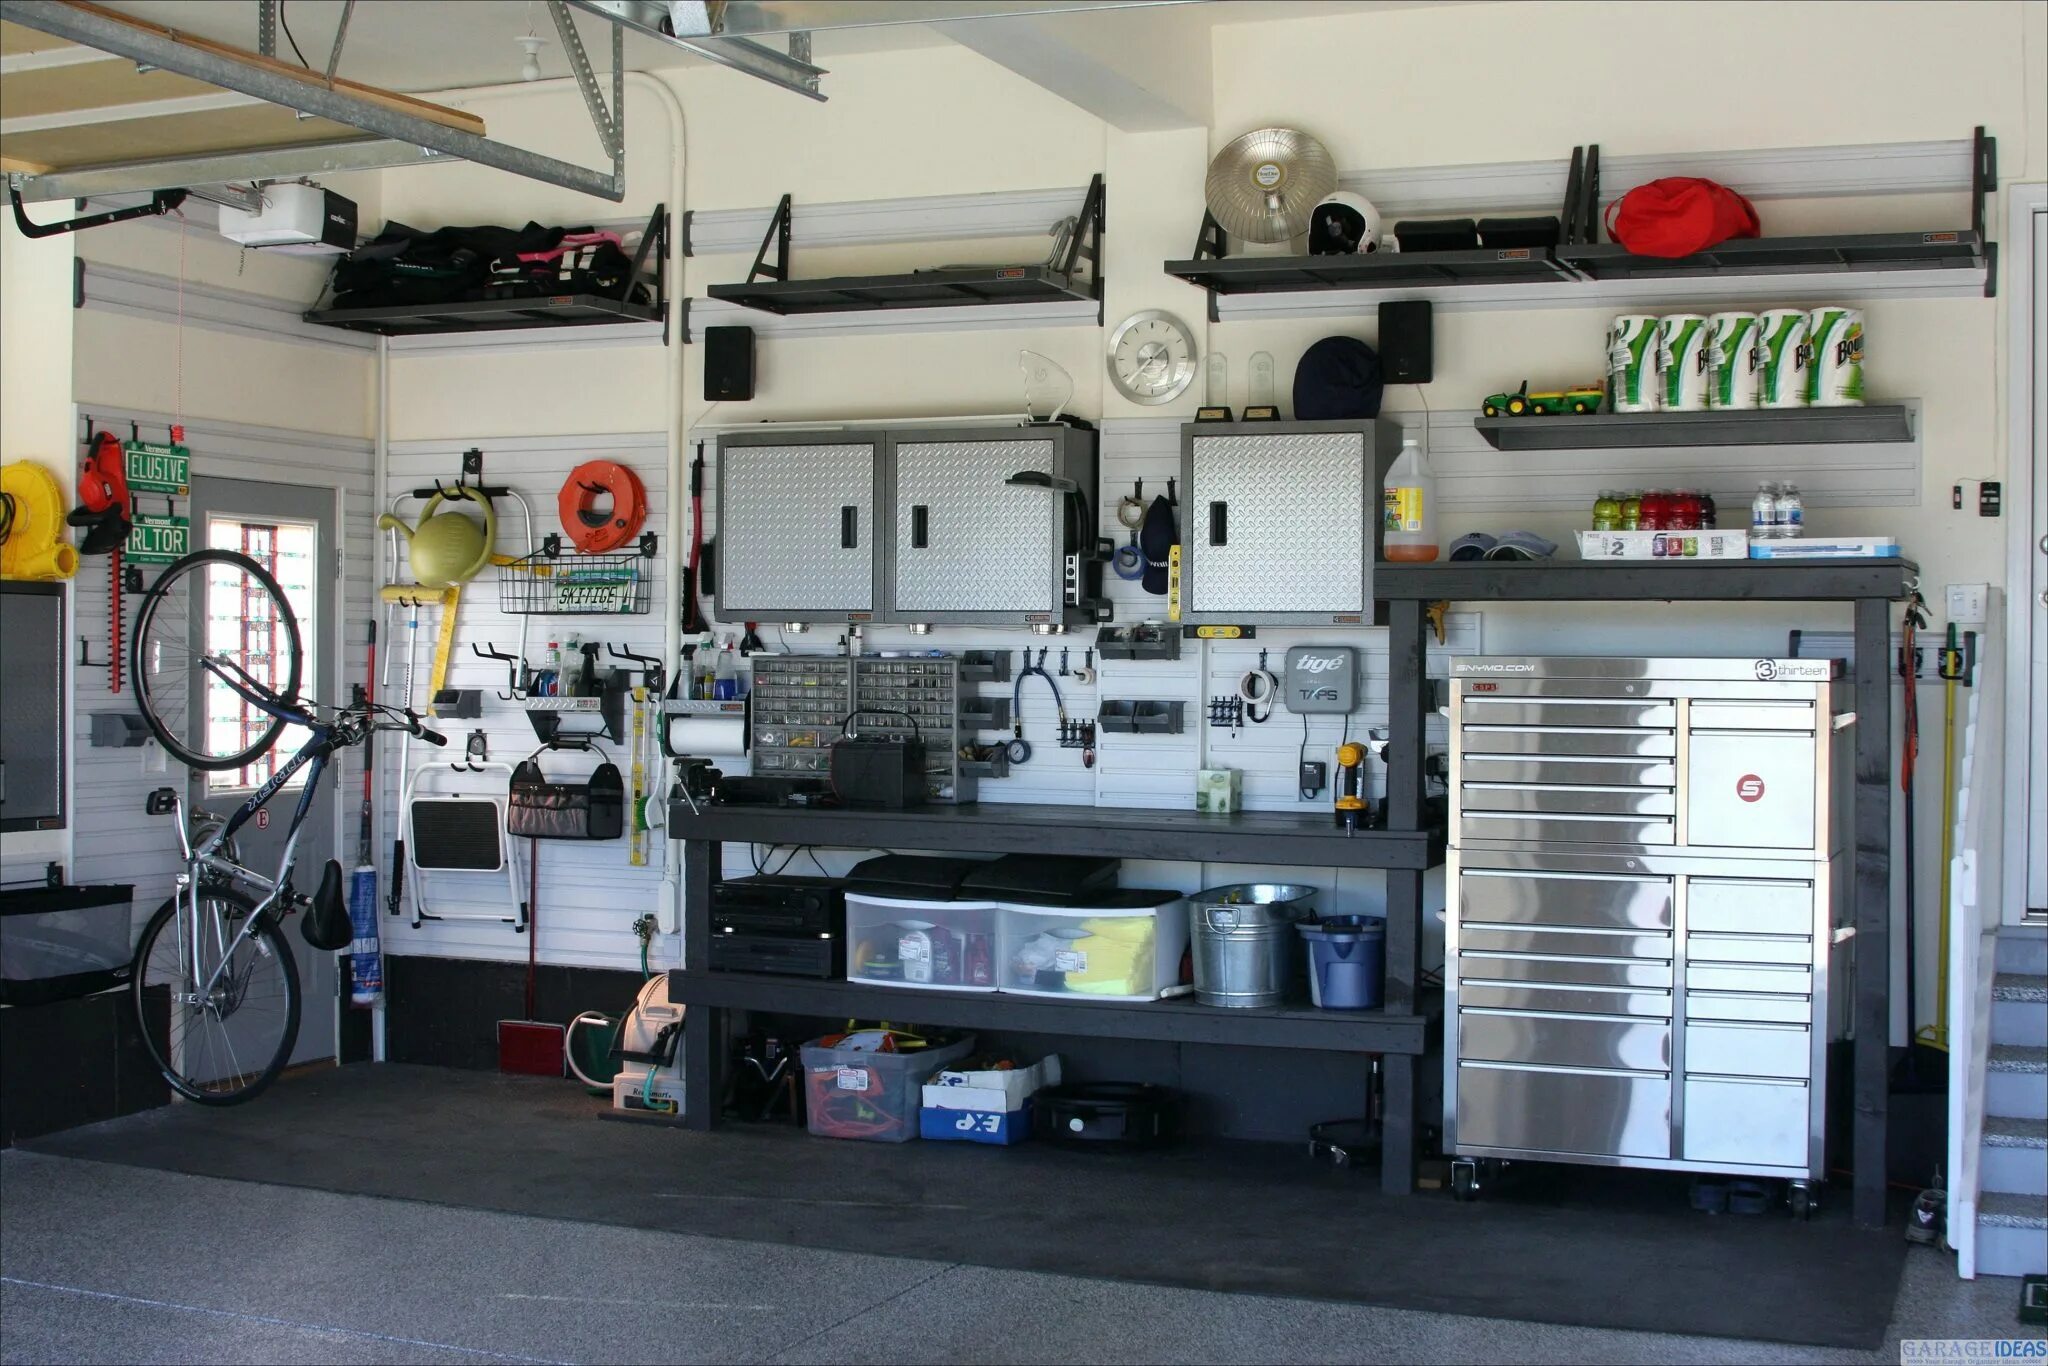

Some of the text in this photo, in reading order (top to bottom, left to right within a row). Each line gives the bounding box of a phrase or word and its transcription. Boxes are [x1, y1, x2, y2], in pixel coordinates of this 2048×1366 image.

[145, 444, 171, 454] Vermont
[131, 454, 185, 483] ELUSIVE
[144, 516, 171, 526] Vermont
[132, 527, 183, 553] RLTOR
[1456, 664, 1535, 672] SNYMO.COM
[1778, 664, 1827, 676] thirteen
[1299, 689, 1338, 701] TAPS
[259, 811, 267, 826] E
[955, 1112, 1001, 1133] EXP
